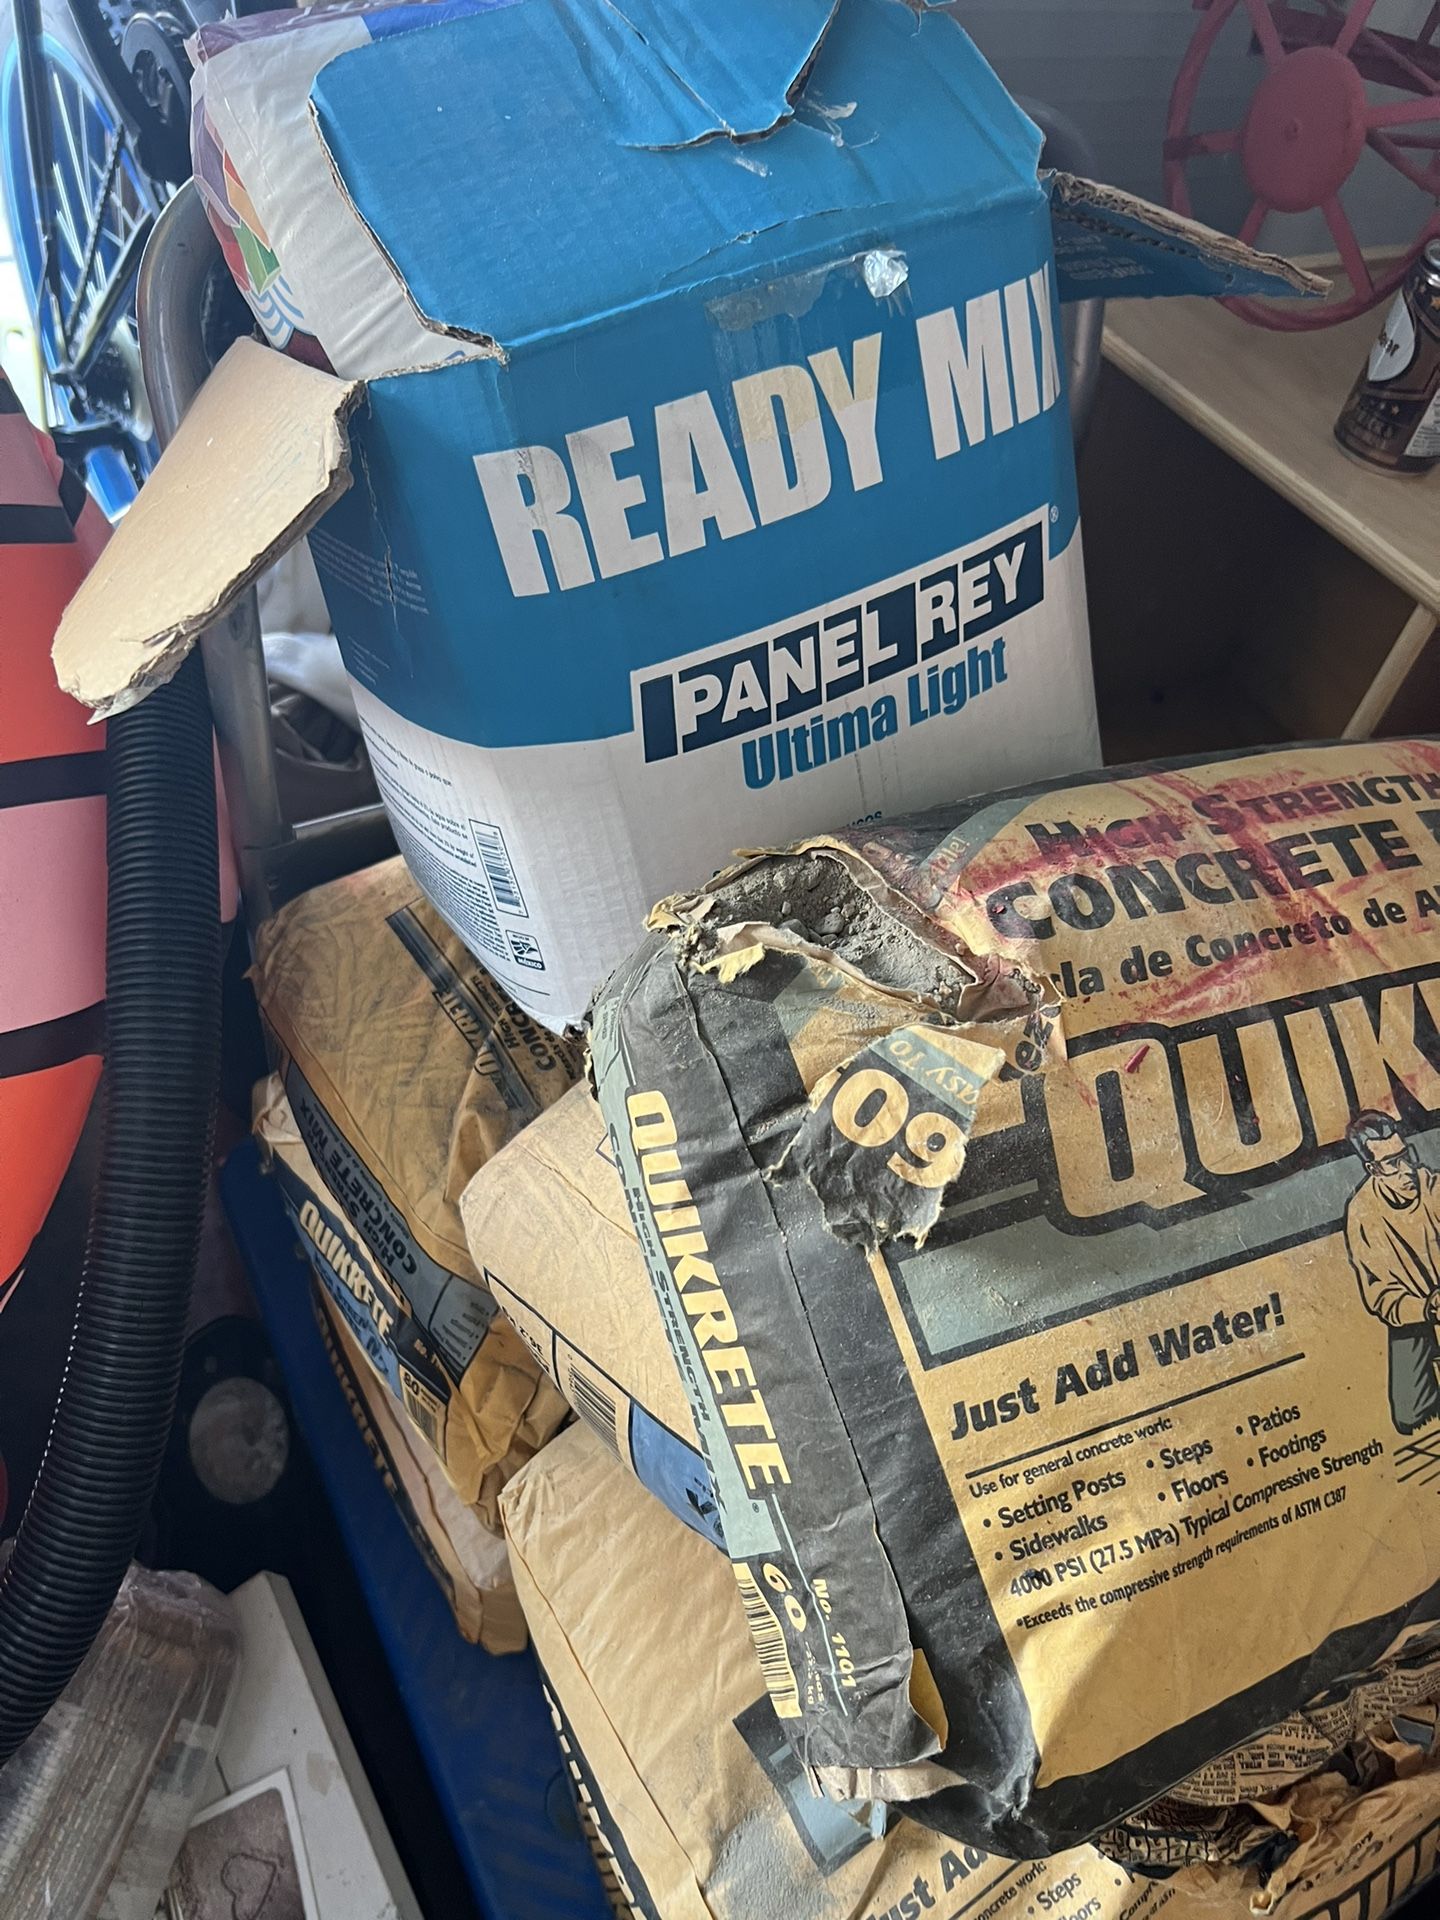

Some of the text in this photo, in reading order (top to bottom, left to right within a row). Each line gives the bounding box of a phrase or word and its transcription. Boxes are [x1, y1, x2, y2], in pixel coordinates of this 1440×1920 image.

[473, 261, 1062, 597] READY MIX
[684, 543, 1026, 737] PANEL REY
[741, 636, 1008, 790] Ultima Light
[1025, 813, 1184, 859] HIGH
[986, 819, 1424, 941] CONCRETE
[1120, 946, 1174, 986] de
[1185, 911, 1353, 968] Concreto
[1363, 898, 1408, 929] de
[469, 974, 521, 1050] HIGH TRENGTH
[889, 1038, 930, 1072] To
[299, 1097, 329, 1149] MIX
[832, 1068, 967, 1190] 60
[329, 1150, 417, 1275] CONCRETE
[364, 1219, 396, 1267] HIGH
[300, 1200, 396, 1345] QUIKRETE
[626, 1089, 792, 1491] QUIKRETE
[631, 1186, 712, 1423] HIGH STRENGTH
[950, 1292, 1287, 1441] Just Add Water!
[969, 1416, 1174, 1499] Use for general concrete work:
[1159, 1437, 1214, 1470] Steps
[1247, 1403, 1302, 1437] Patios
[1257, 1428, 1327, 1469] Footings
[996, 1468, 1127, 1529] Setting Posts
[1009, 1438, 1385, 1598] 4000 PSI (27.5 MPa) Typical Compressive Strength
[1171, 1468, 1231, 1504] Floors
[1007, 1512, 1109, 1563] Sidewalks
[1075, 1595, 1098, 1614] the
[1098, 1567, 1171, 1607] compressive
[1171, 1544, 1215, 1582] strength
[1214, 1515, 1281, 1560] requirements
[1280, 1508, 1294, 1526] of
[1293, 1496, 1323, 1522] ASTM
[1322, 1484, 1349, 1515] C387
[762, 1562, 807, 1632] 60
[813, 1578, 832, 1622] No.
[831, 1632, 857, 1688] 1101
[1017, 1860, 1048, 1898] work:
[1035, 1872, 1083, 1912] Steps
